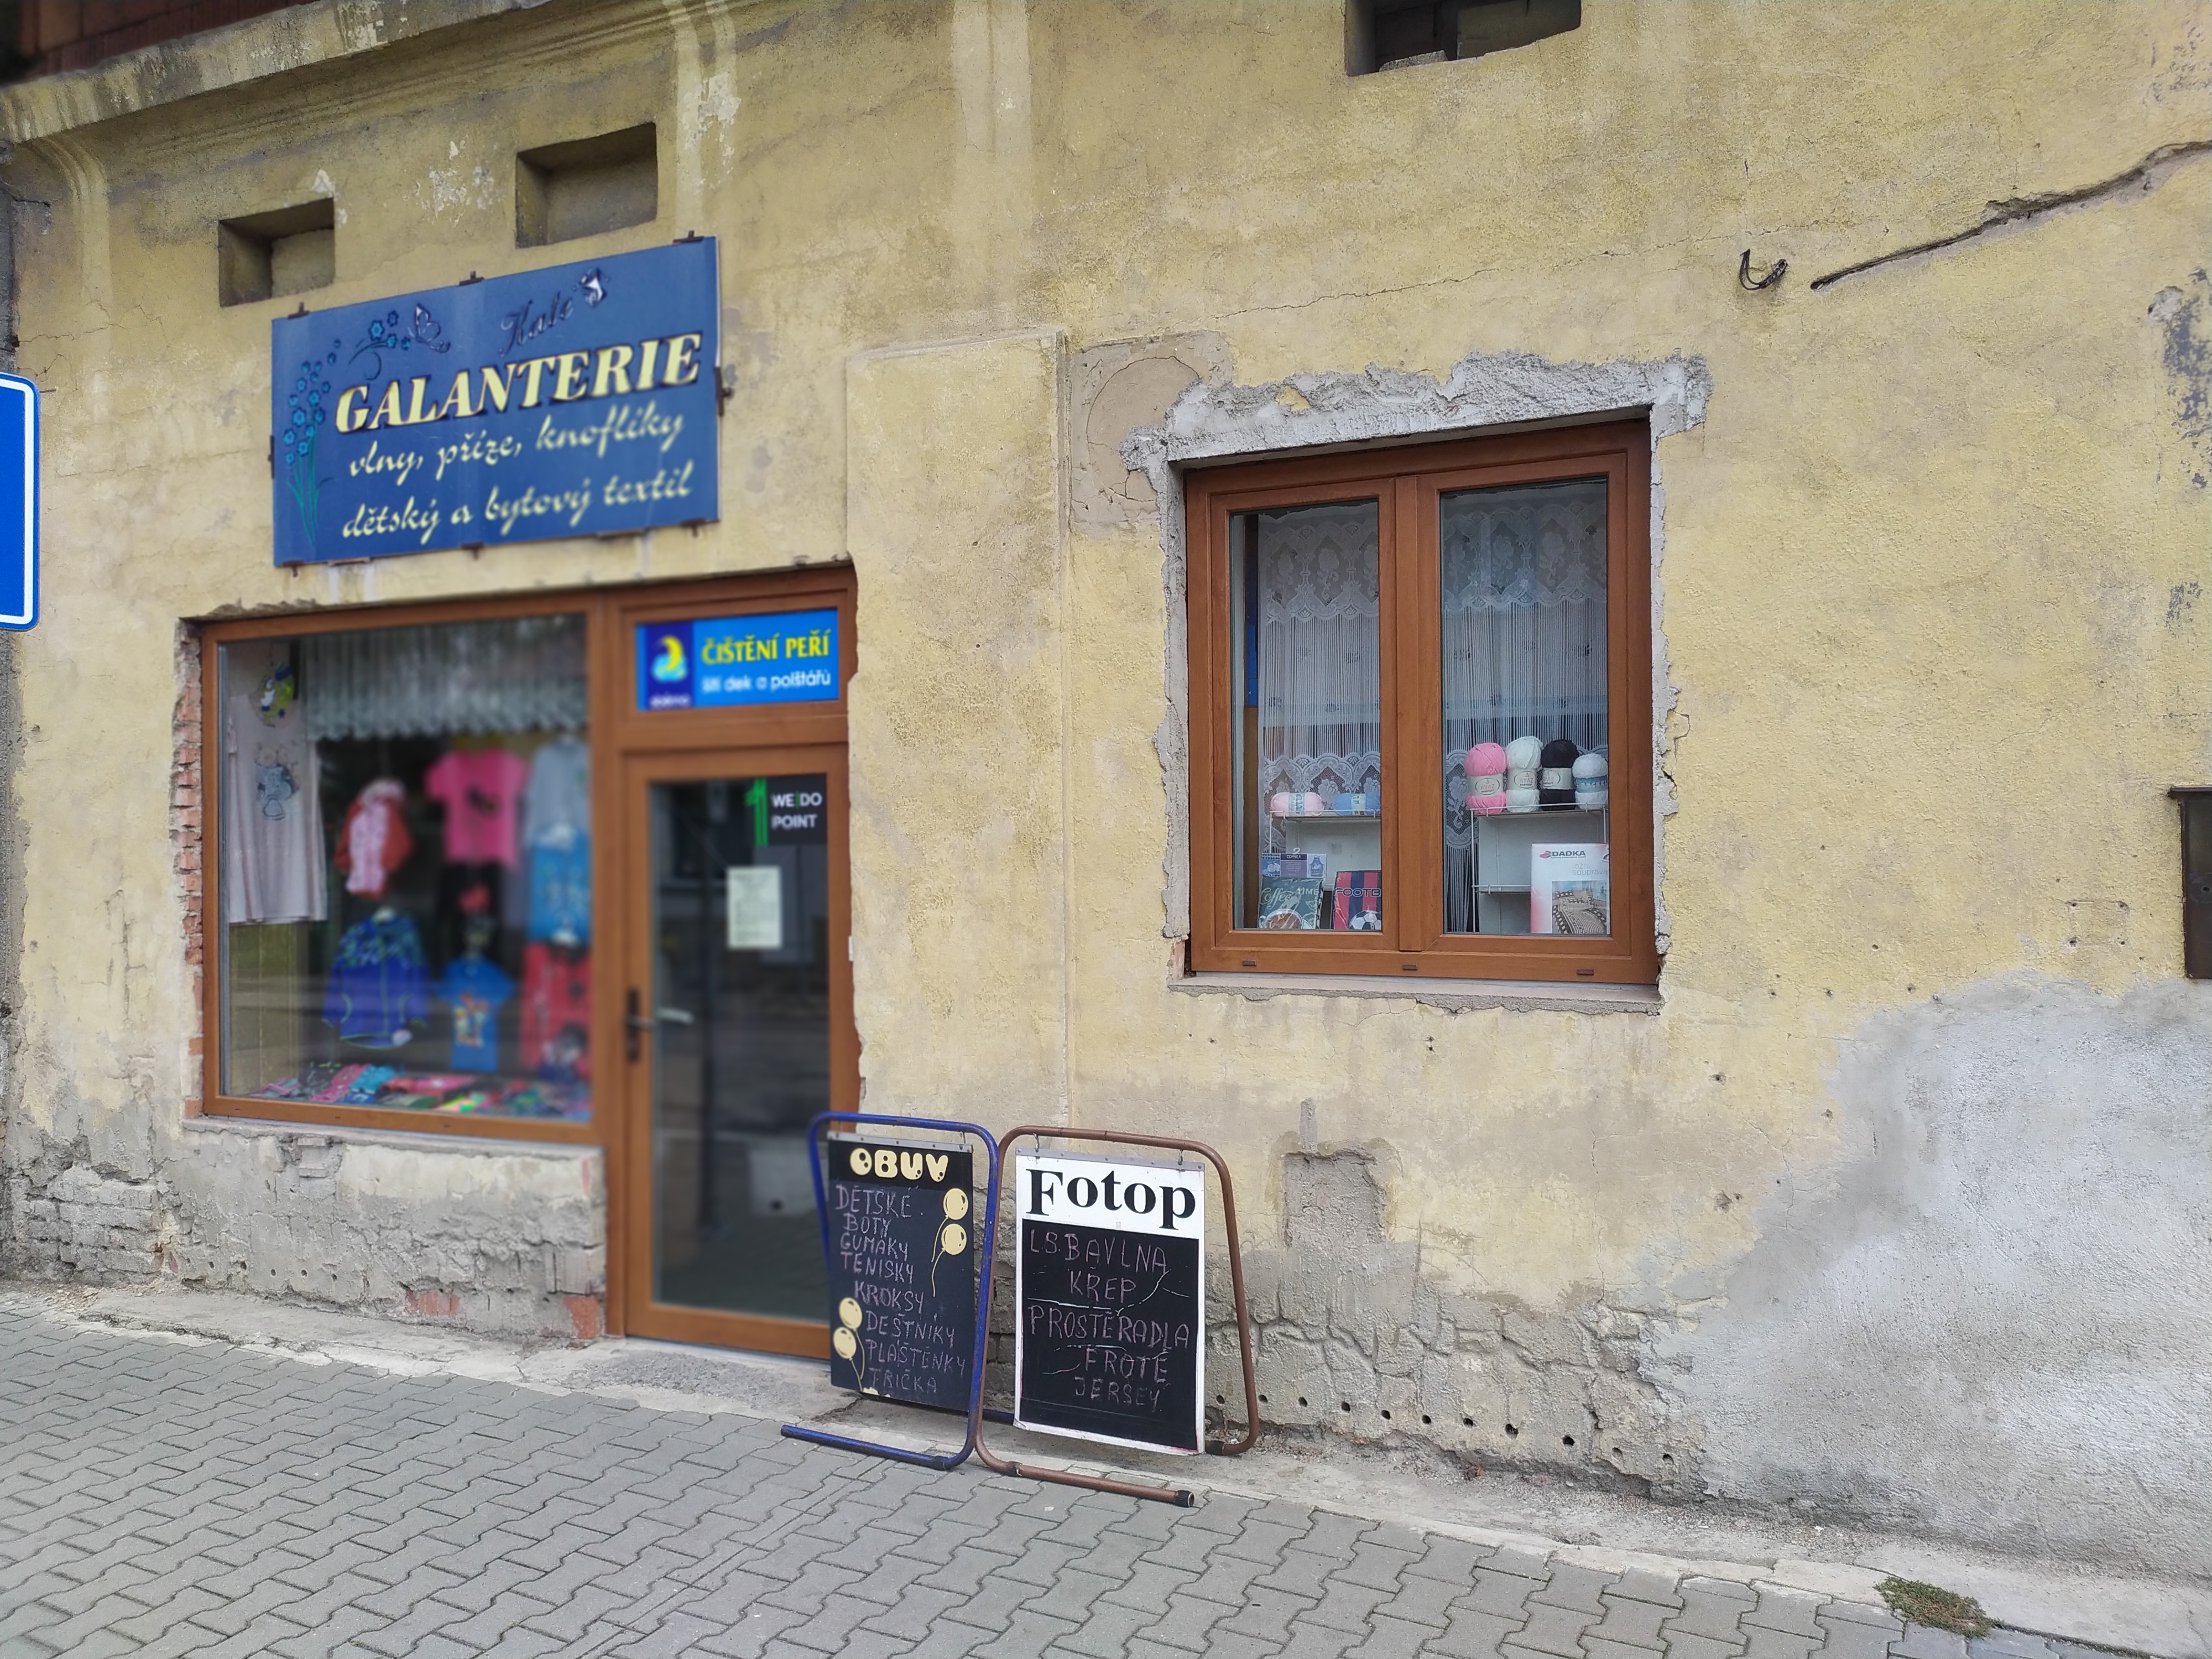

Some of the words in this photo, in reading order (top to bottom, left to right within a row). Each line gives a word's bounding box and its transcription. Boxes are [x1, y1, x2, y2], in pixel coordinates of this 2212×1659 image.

[336, 332, 703, 434] GALANTERIE
[349, 441, 424, 486] vlny,
[437, 428, 522, 480] příze,
[536, 401, 685, 457] knoflíky
[342, 496, 442, 544] dětský
[451, 504, 473, 524] a
[485, 478, 591, 534] bytový
[603, 461, 695, 507] textil
[701, 633, 780, 664] ČIŠTĚNÍ
[785, 628, 831, 659] PEŘÍ
[771, 670, 831, 691] polštářů
[771, 814, 817, 830] POINT
[1260, 887, 1295, 910] Coffee
[1297, 887, 1319, 895] TIME
[1333, 887, 1381, 898] FOOTB
[850, 1148, 948, 1182] OBUV
[1026, 1168, 1196, 1230] Fotop
[843, 1212, 892, 1238] BOTY
[840, 1251, 913, 1284] TENISKY
[1064, 1233, 1167, 1273] BAVLNA
[854, 1280, 924, 1314] KROKSY
[1074, 1376, 1160, 1412] JERSEY
